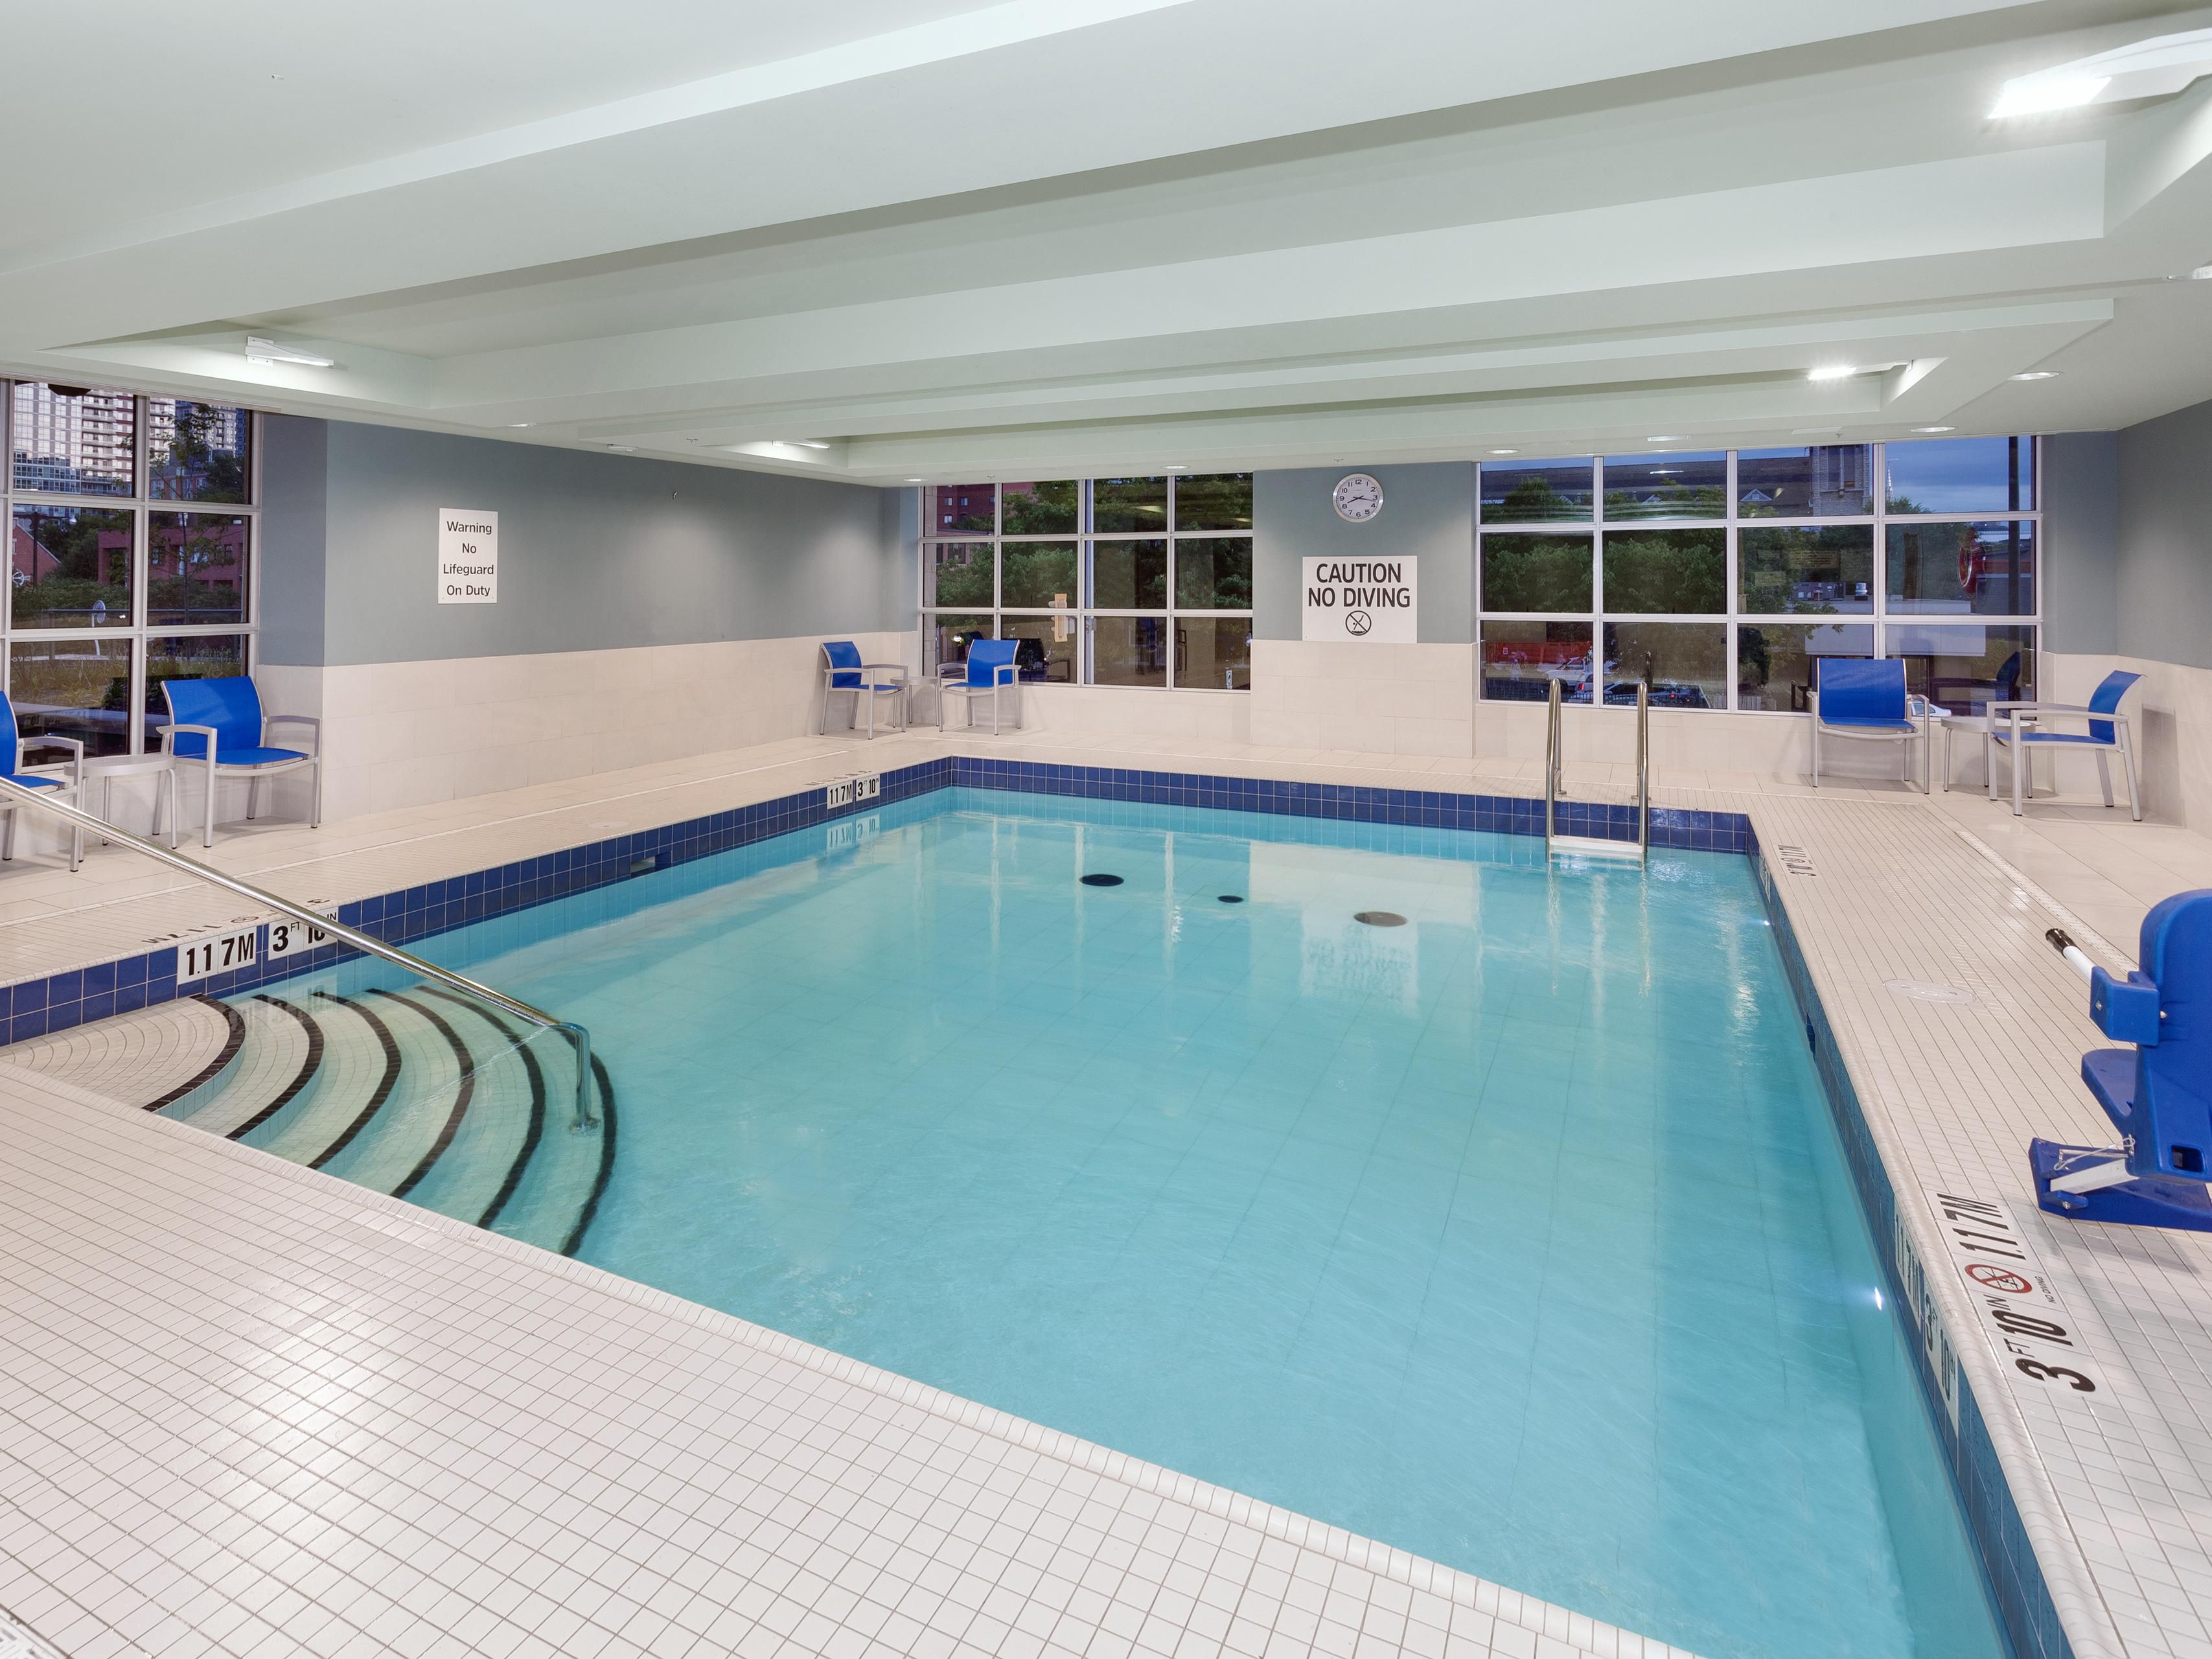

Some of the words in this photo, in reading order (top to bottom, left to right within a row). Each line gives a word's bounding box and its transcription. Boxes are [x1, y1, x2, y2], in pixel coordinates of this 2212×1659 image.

[446, 521, 492, 535] Warning
[462, 543, 477, 553] No
[443, 564, 494, 575] Lifeguard
[1317, 563, 1401, 583] CAUTION
[446, 585, 462, 596] On
[466, 585, 490, 597] Duty
[1308, 587, 1335, 607] NO
[1344, 587, 1411, 607] DIVING
